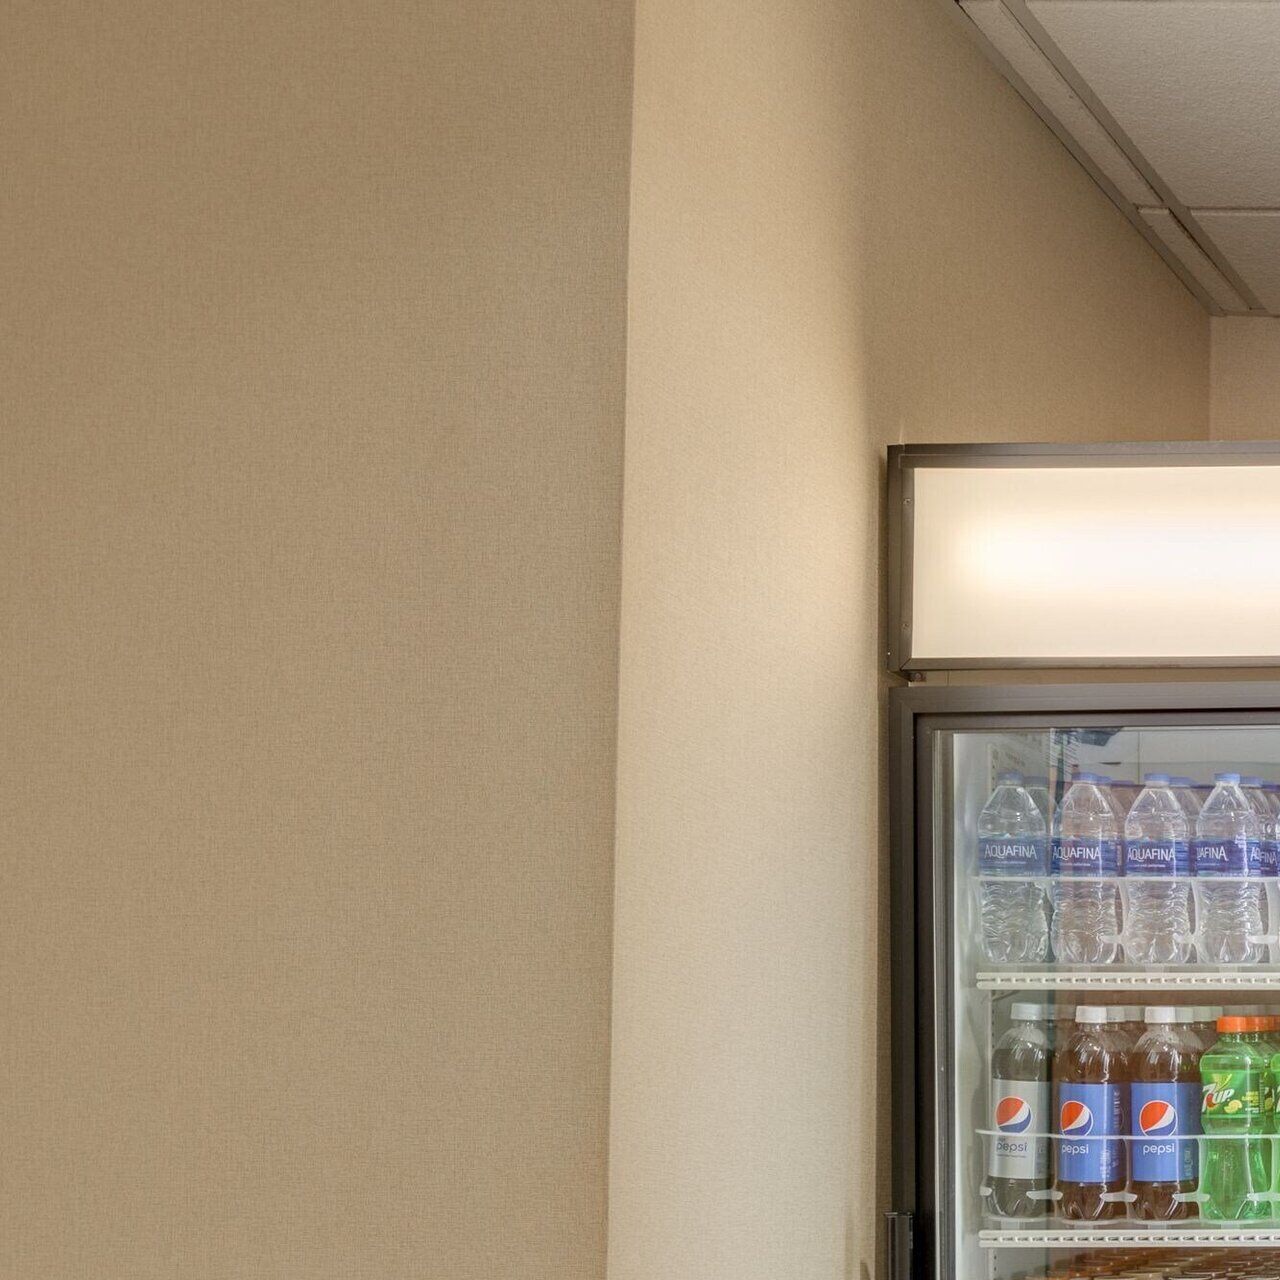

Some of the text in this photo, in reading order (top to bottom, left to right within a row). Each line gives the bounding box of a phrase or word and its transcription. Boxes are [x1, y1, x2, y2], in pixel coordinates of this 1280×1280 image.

[985, 845, 1037, 859] AQUAFINA
[1052, 846, 1100, 861] AQUAFINA
[1127, 847, 1175, 862] AQUAFINA
[996, 1142, 1027, 1152] pepsi
[1062, 1144, 1088, 1154] pepsi
[1143, 1143, 1175, 1155] pepsi
